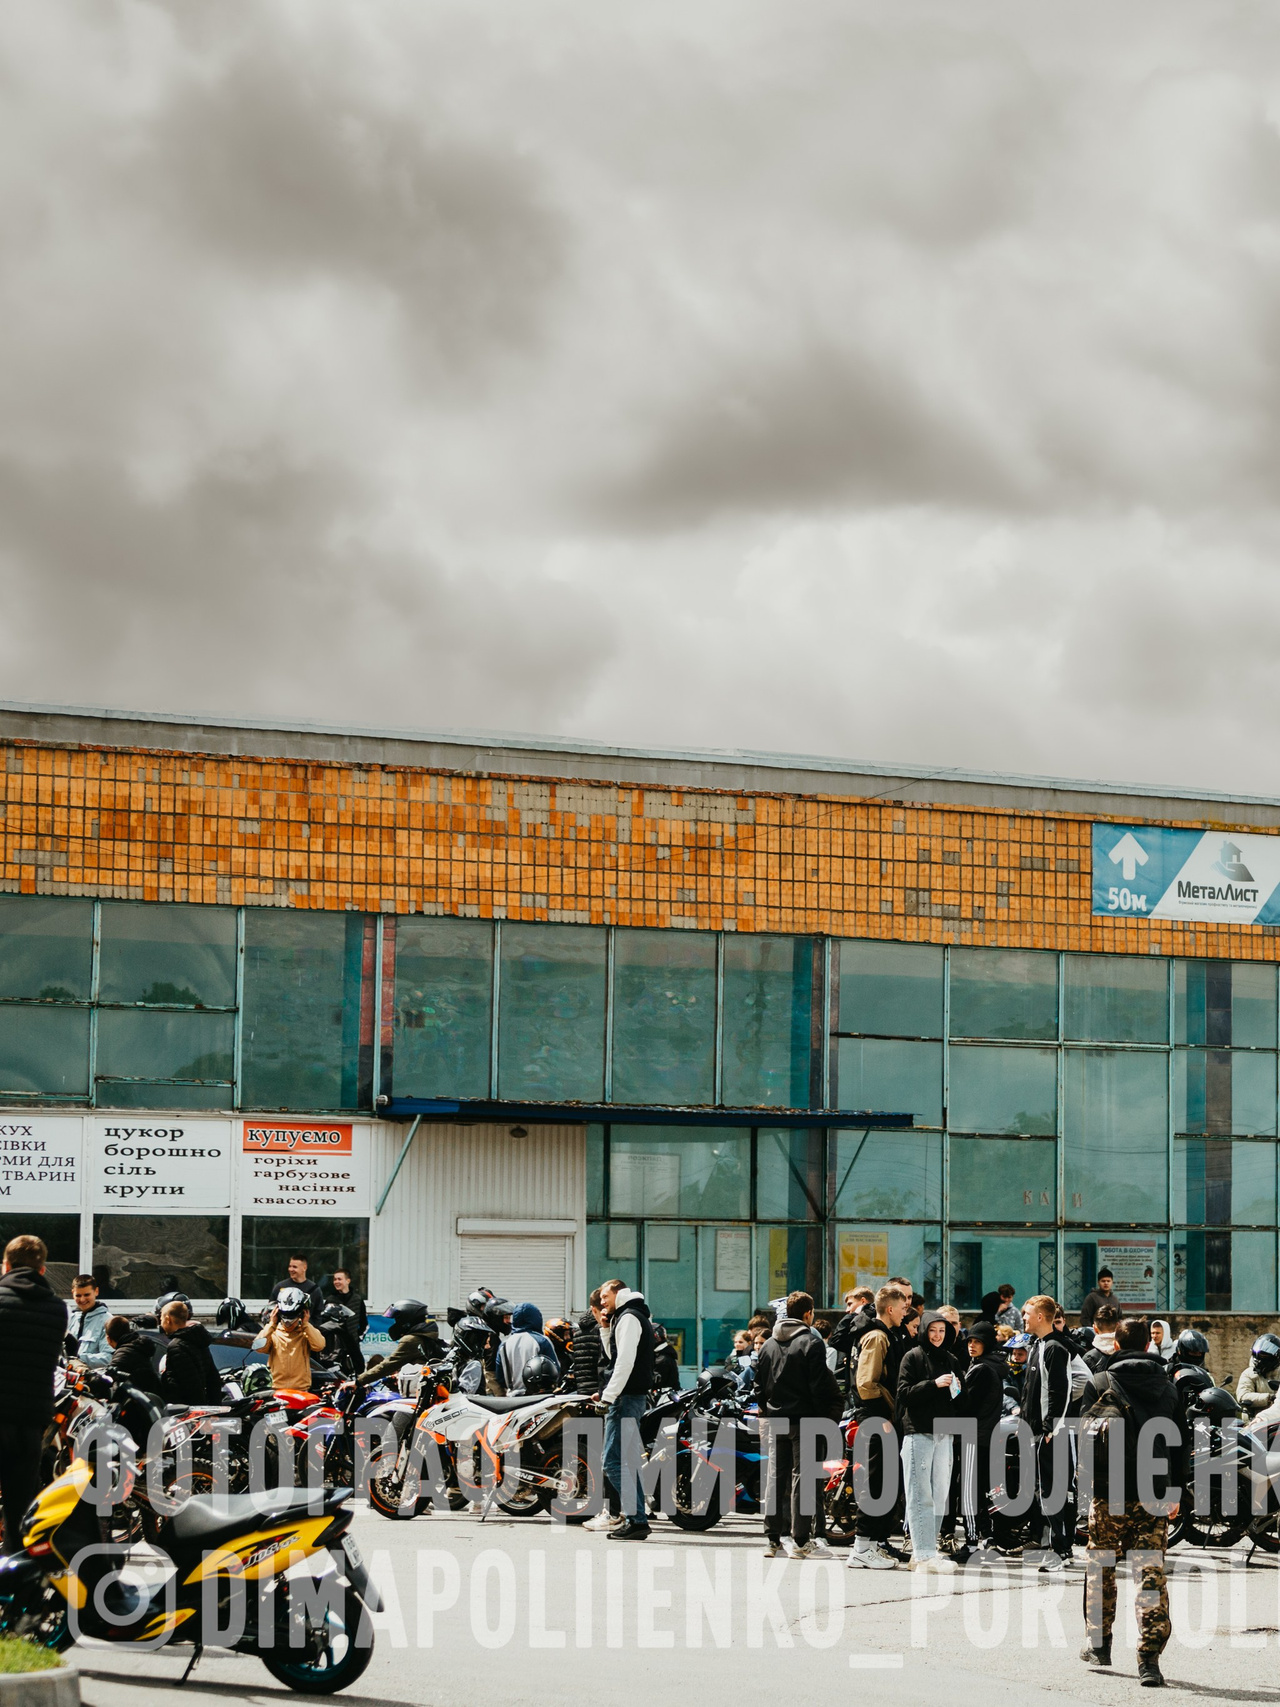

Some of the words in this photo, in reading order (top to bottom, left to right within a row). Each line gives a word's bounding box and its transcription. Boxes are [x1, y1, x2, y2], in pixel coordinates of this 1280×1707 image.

[1177, 880, 1259, 902] МеталЛист
[1108, 887, 1148, 912] 50м
[104, 1128, 184, 1142] цукор
[248, 1129, 341, 1147] купуємо
[0, 1140, 46, 1151] ІВКИ
[104, 1143, 221, 1160] борошно
[0, 1155, 32, 1166] МИ
[38, 1156, 75, 1168] ДЛЯ
[254, 1156, 318, 1167] горіхи
[103, 1163, 157, 1175] сіль
[253, 1169, 350, 1181] гарбузове
[2, 1170, 76, 1182] ТВАРИН
[103, 1185, 185, 1198] крупи
[278, 1183, 356, 1193] насіння
[253, 1197, 337, 1205] квасолю
[166, 1428, 186, 1447] 15
